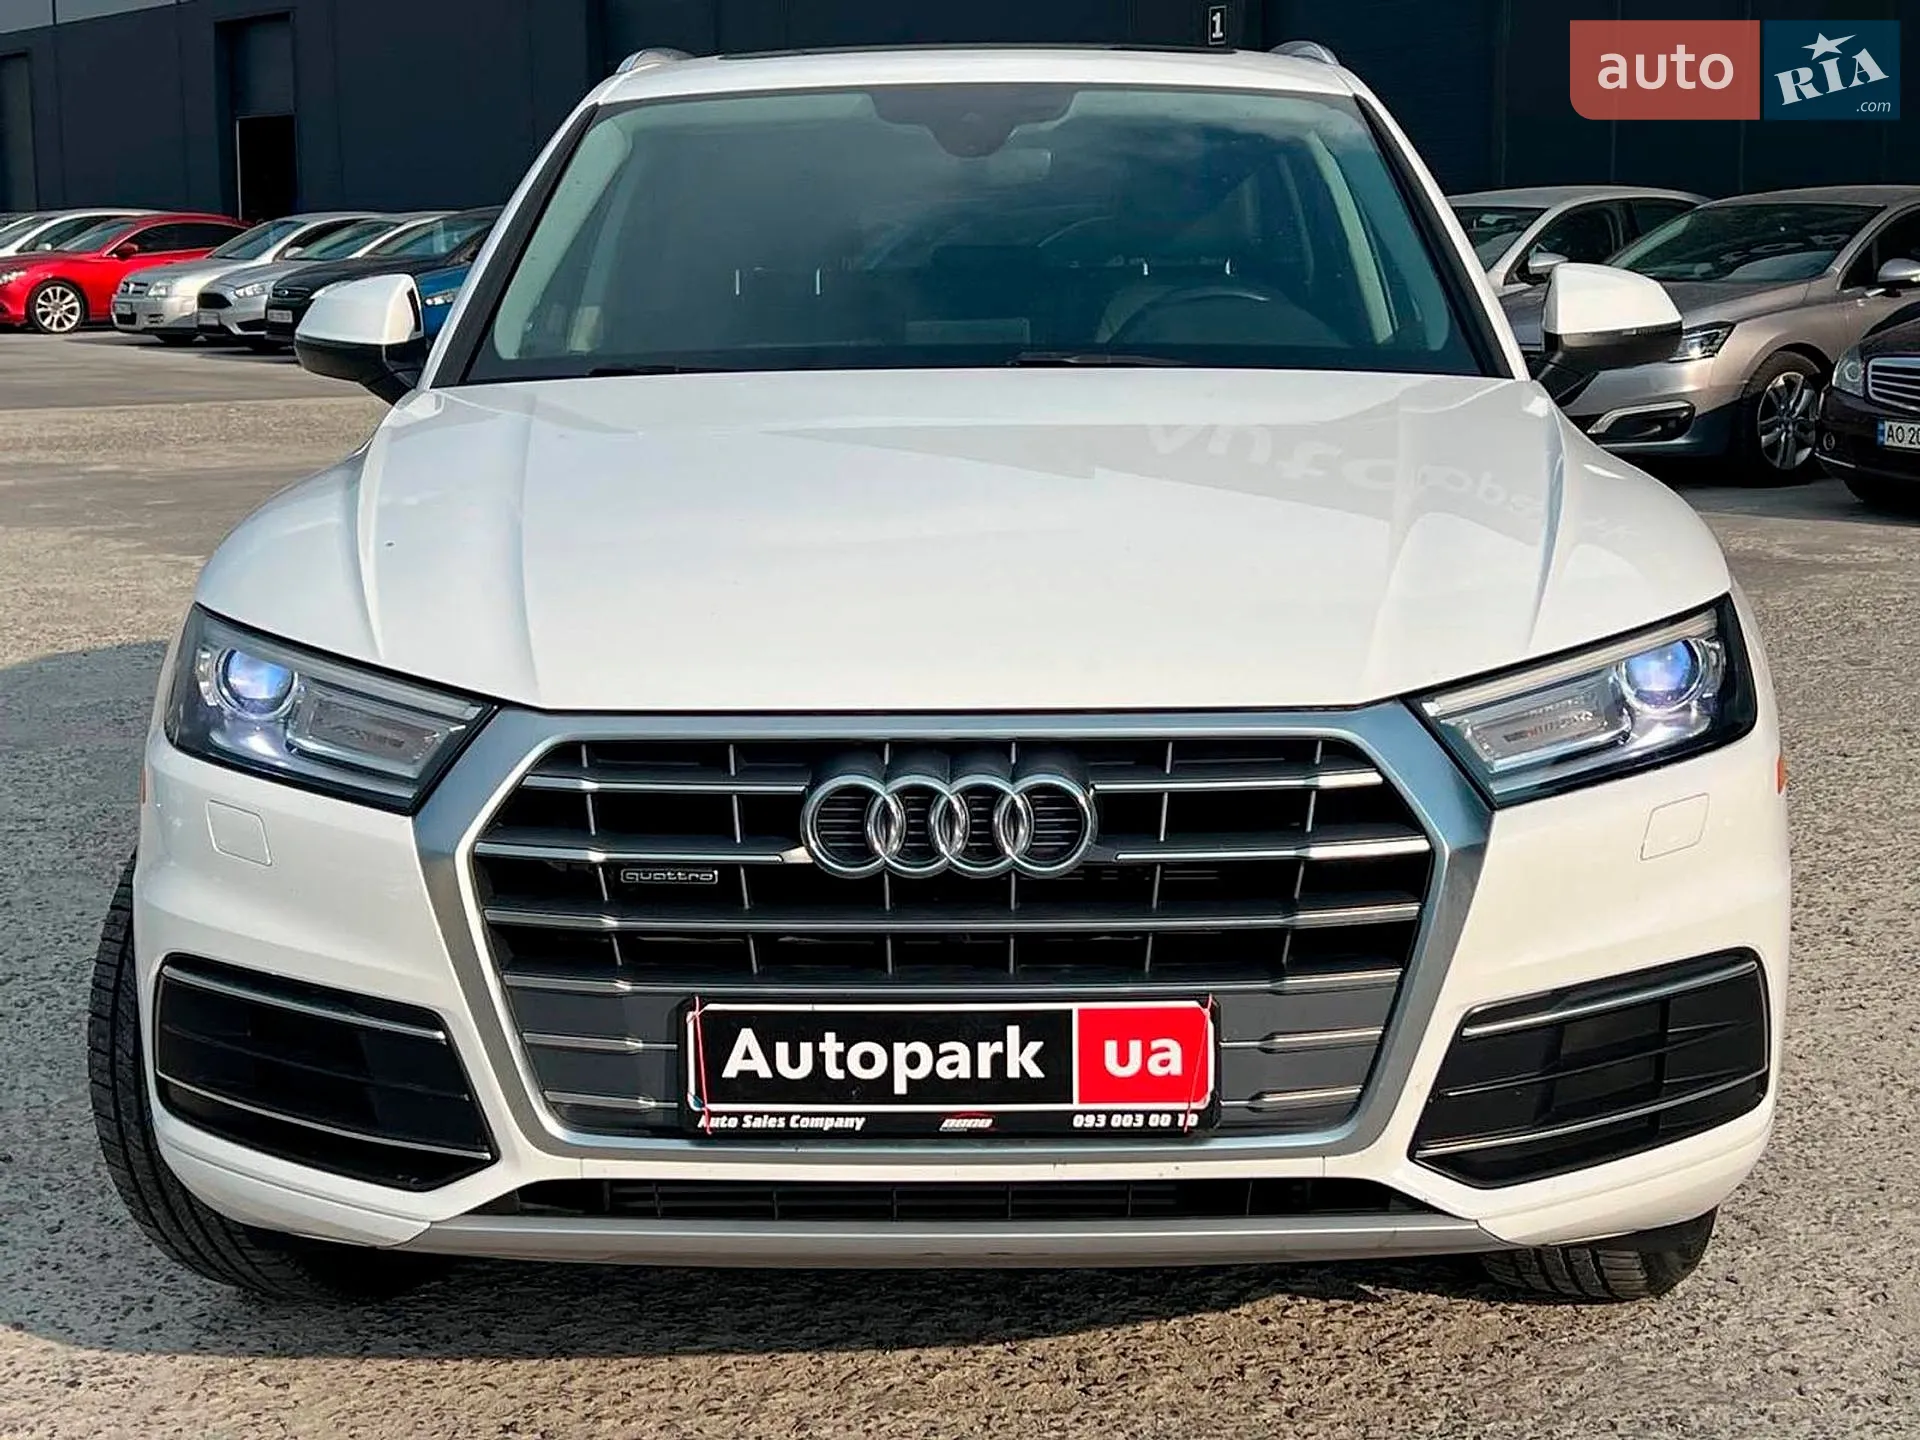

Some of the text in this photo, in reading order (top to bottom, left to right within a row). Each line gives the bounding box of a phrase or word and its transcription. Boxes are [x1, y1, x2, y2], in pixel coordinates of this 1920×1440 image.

[1212, 12, 1223, 38] 1
[1887, 424, 1905, 443] AO
[625, 871, 714, 883] quattro
[721, 1025, 1184, 1095] Autopark ua
[698, 1114, 867, 1132] Auto Sales Company
[1072, 1113, 1107, 1128] 093
[1110, 1113, 1145, 1128] 003
[1148, 1113, 1172, 1128] 00
